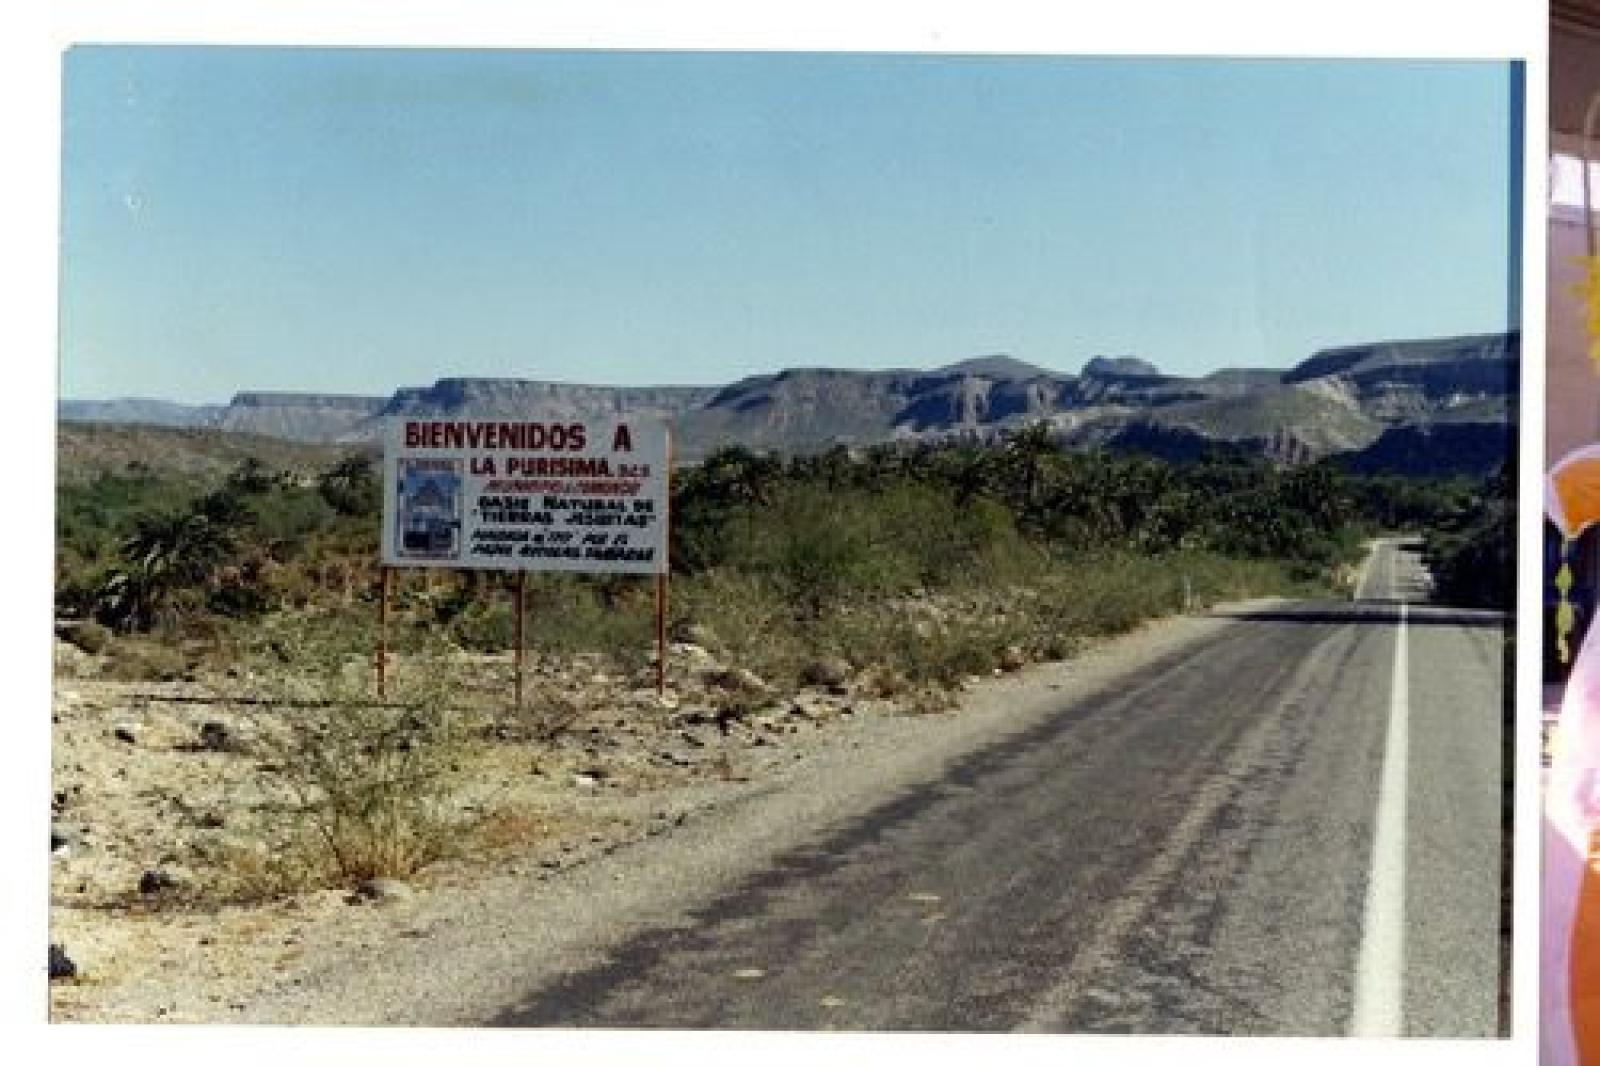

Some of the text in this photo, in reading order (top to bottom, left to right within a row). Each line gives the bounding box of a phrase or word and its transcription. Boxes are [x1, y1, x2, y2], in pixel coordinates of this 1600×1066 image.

[405, 422, 632, 451] BIENVENIDOS A
[469, 457, 497, 475] LA
